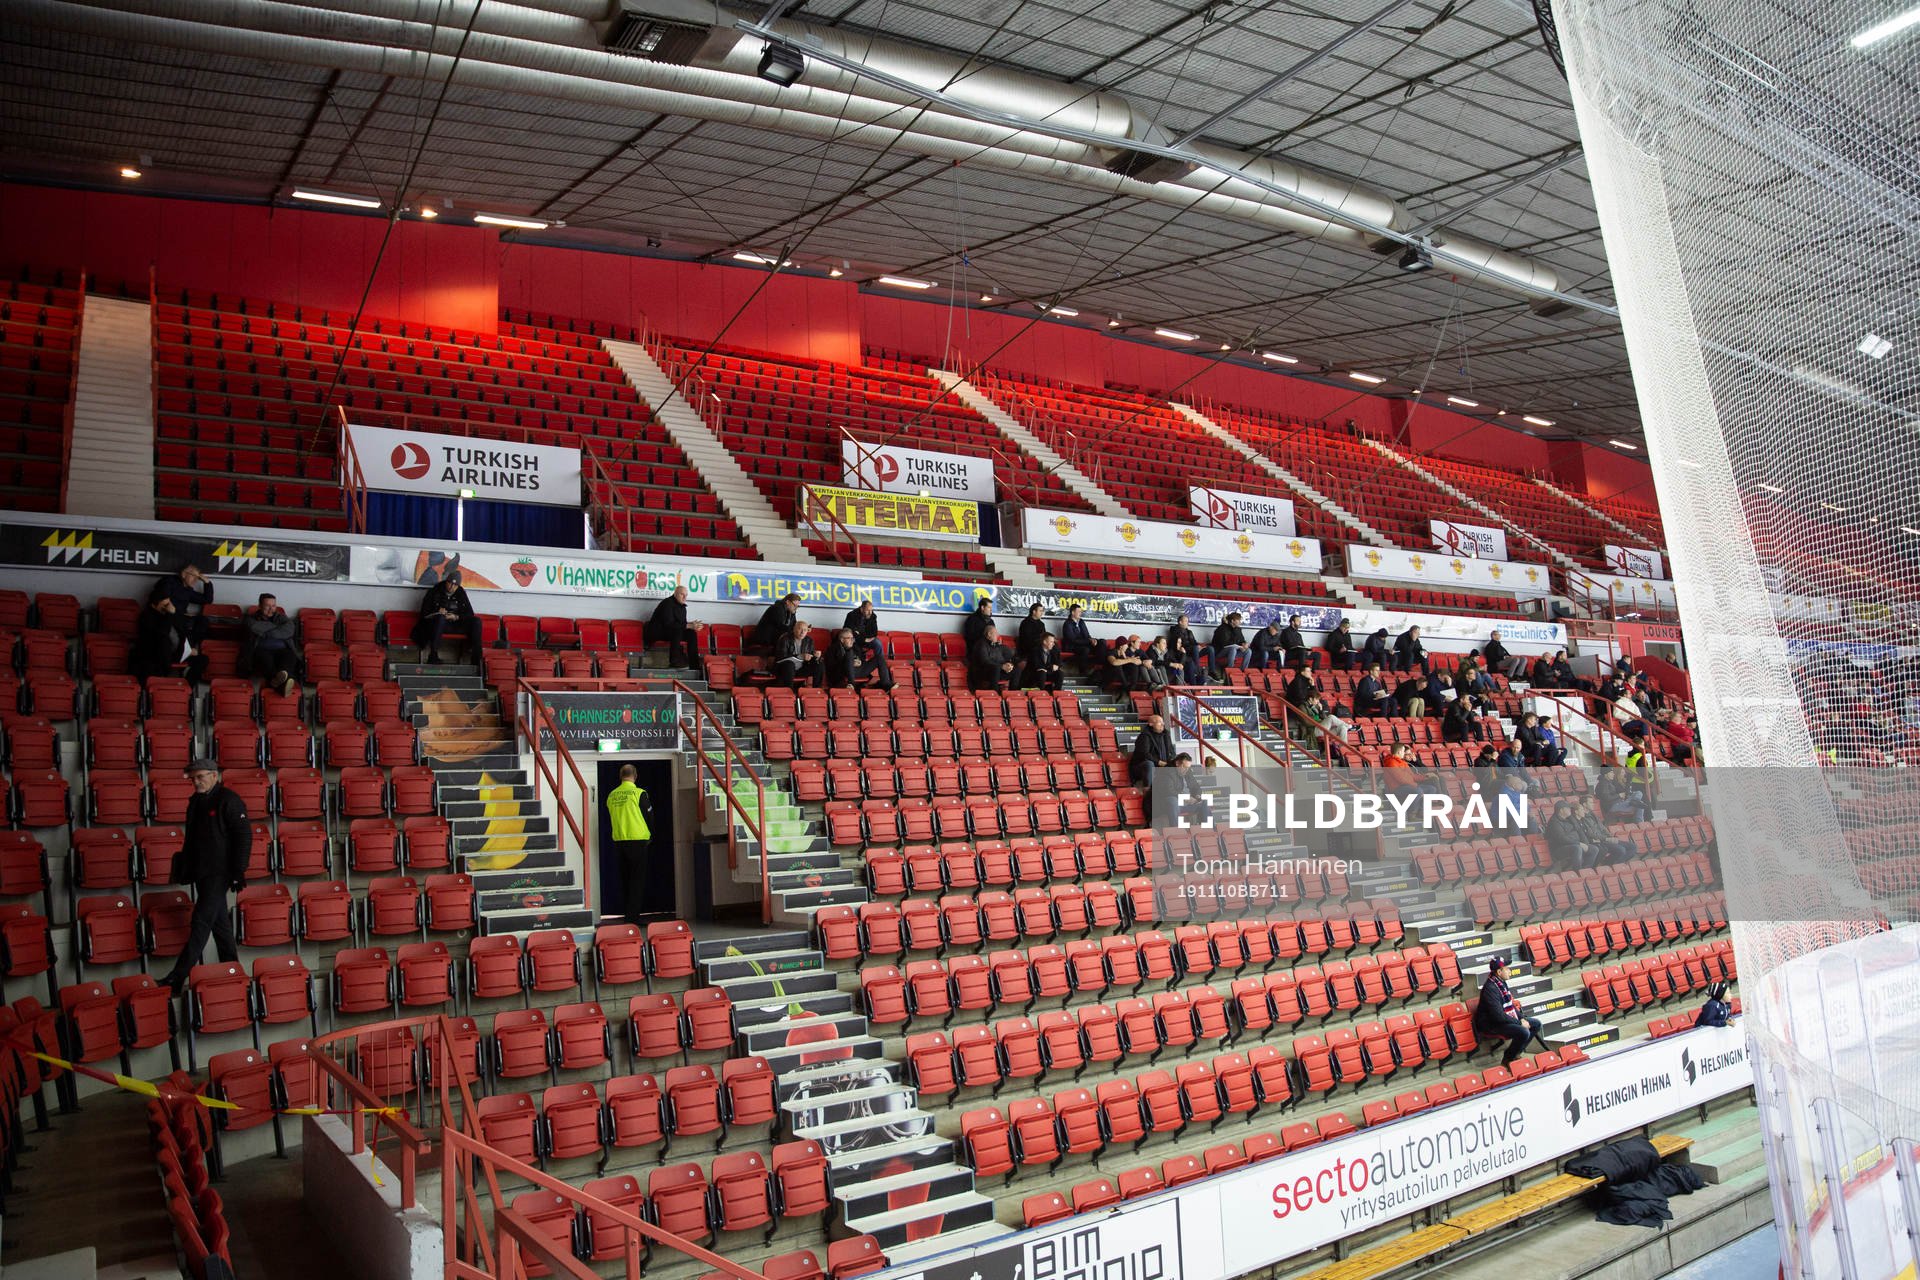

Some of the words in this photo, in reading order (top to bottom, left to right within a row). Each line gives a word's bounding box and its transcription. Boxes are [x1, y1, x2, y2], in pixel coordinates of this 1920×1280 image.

[442, 446, 538, 471] TURKISH
[906, 457, 967, 477] TURKISH
[441, 467, 540, 490] AIRLINES
[906, 472, 969, 491] AIRLINES
[1233, 499, 1276, 515] TURKISH
[1235, 514, 1278, 527] AIRLINES
[100, 548, 159, 565] HELEN
[1463, 541, 1494, 553] AIRINES
[264, 557, 316, 574] HELEN
[689, 574, 708, 593] OY
[757, 578, 873, 602] HELSINGIN
[880, 586, 964, 608] LEDVALO
[1090, 599, 1118, 613] 0700
[1643, 624, 1680, 639] LOUNGE
[661, 709, 675, 724] OY
[1700, 1047, 1743, 1075] HELSINGIN
[1585, 1082, 1638, 1115] HELSINGIN
[1641, 1072, 1672, 1096] HIHNA
[1340, 1172, 1449, 1229] yritysautoilun
[1453, 1143, 1528, 1189] palvelutalo
[1032, 1226, 1101, 1280] BIM
